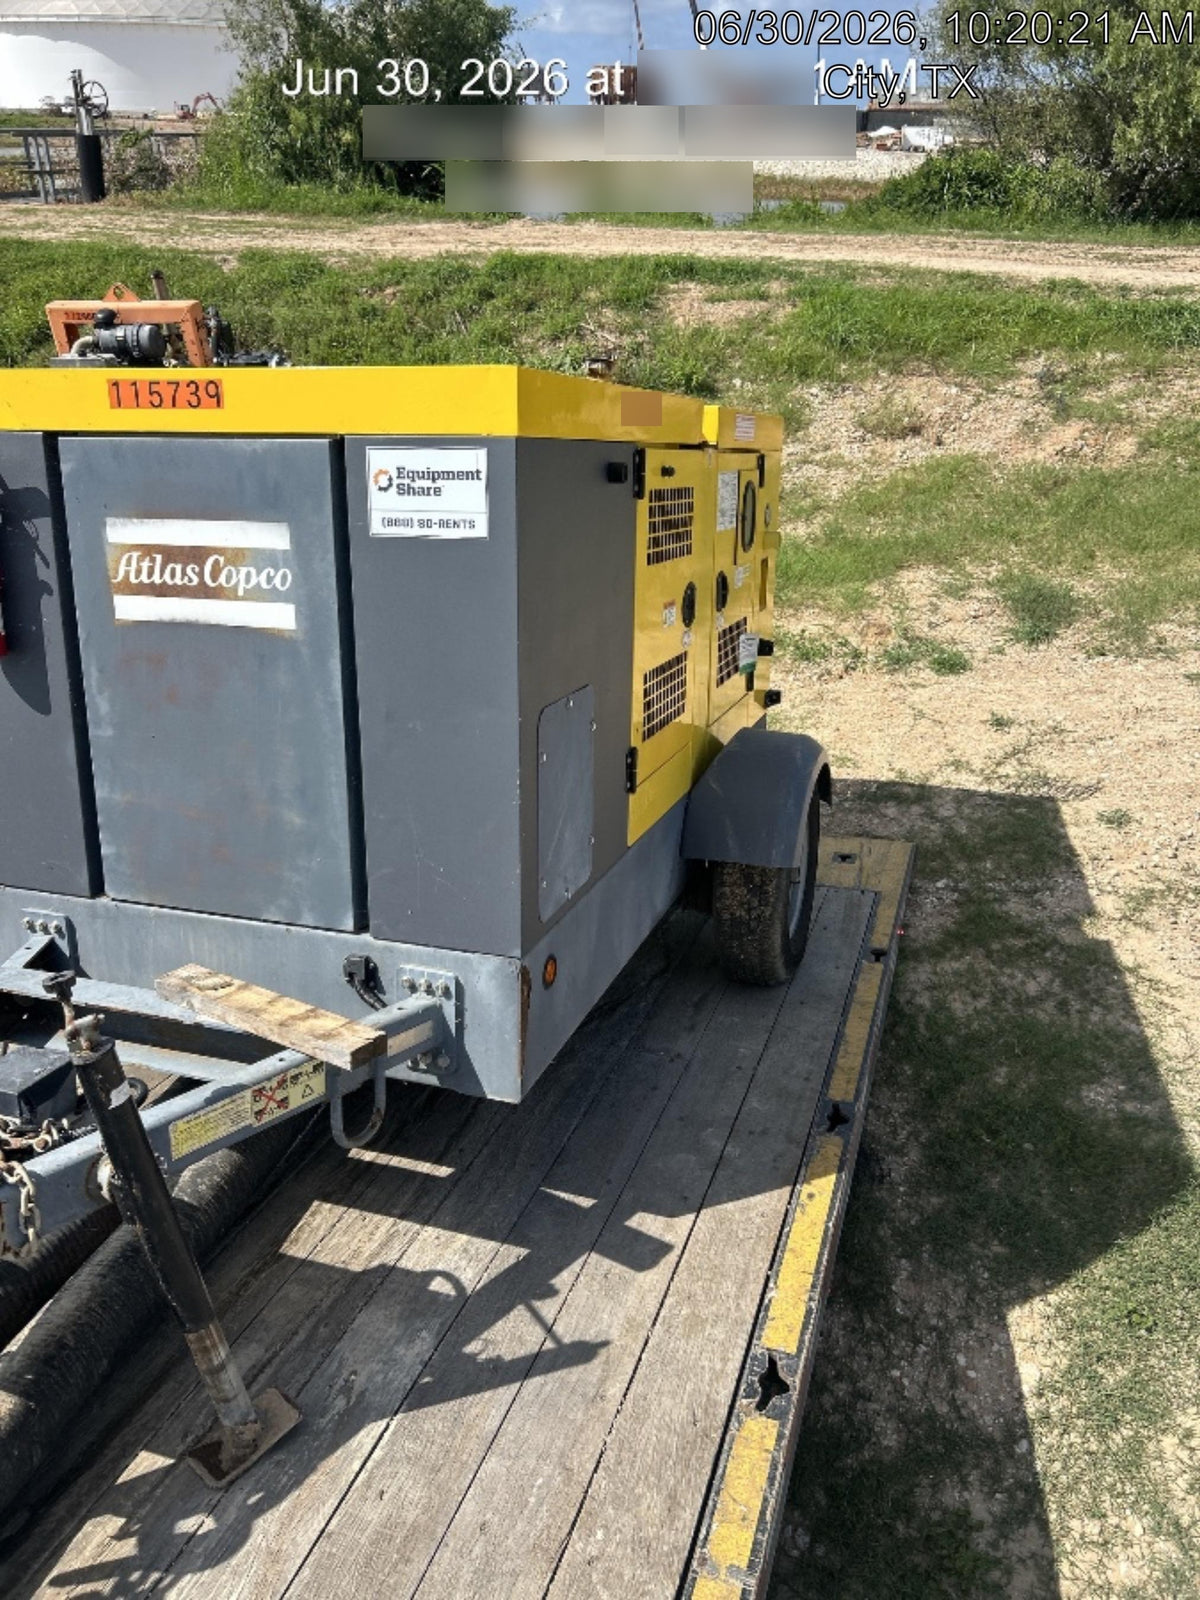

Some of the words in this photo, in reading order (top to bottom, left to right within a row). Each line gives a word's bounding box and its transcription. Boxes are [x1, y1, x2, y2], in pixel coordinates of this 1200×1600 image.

[110, 379, 223, 410] 115739
[395, 466, 483, 483] Equipment
[395, 482, 443, 497] Share
[111, 550, 200, 586] Atlas
[203, 553, 293, 597] Copco
